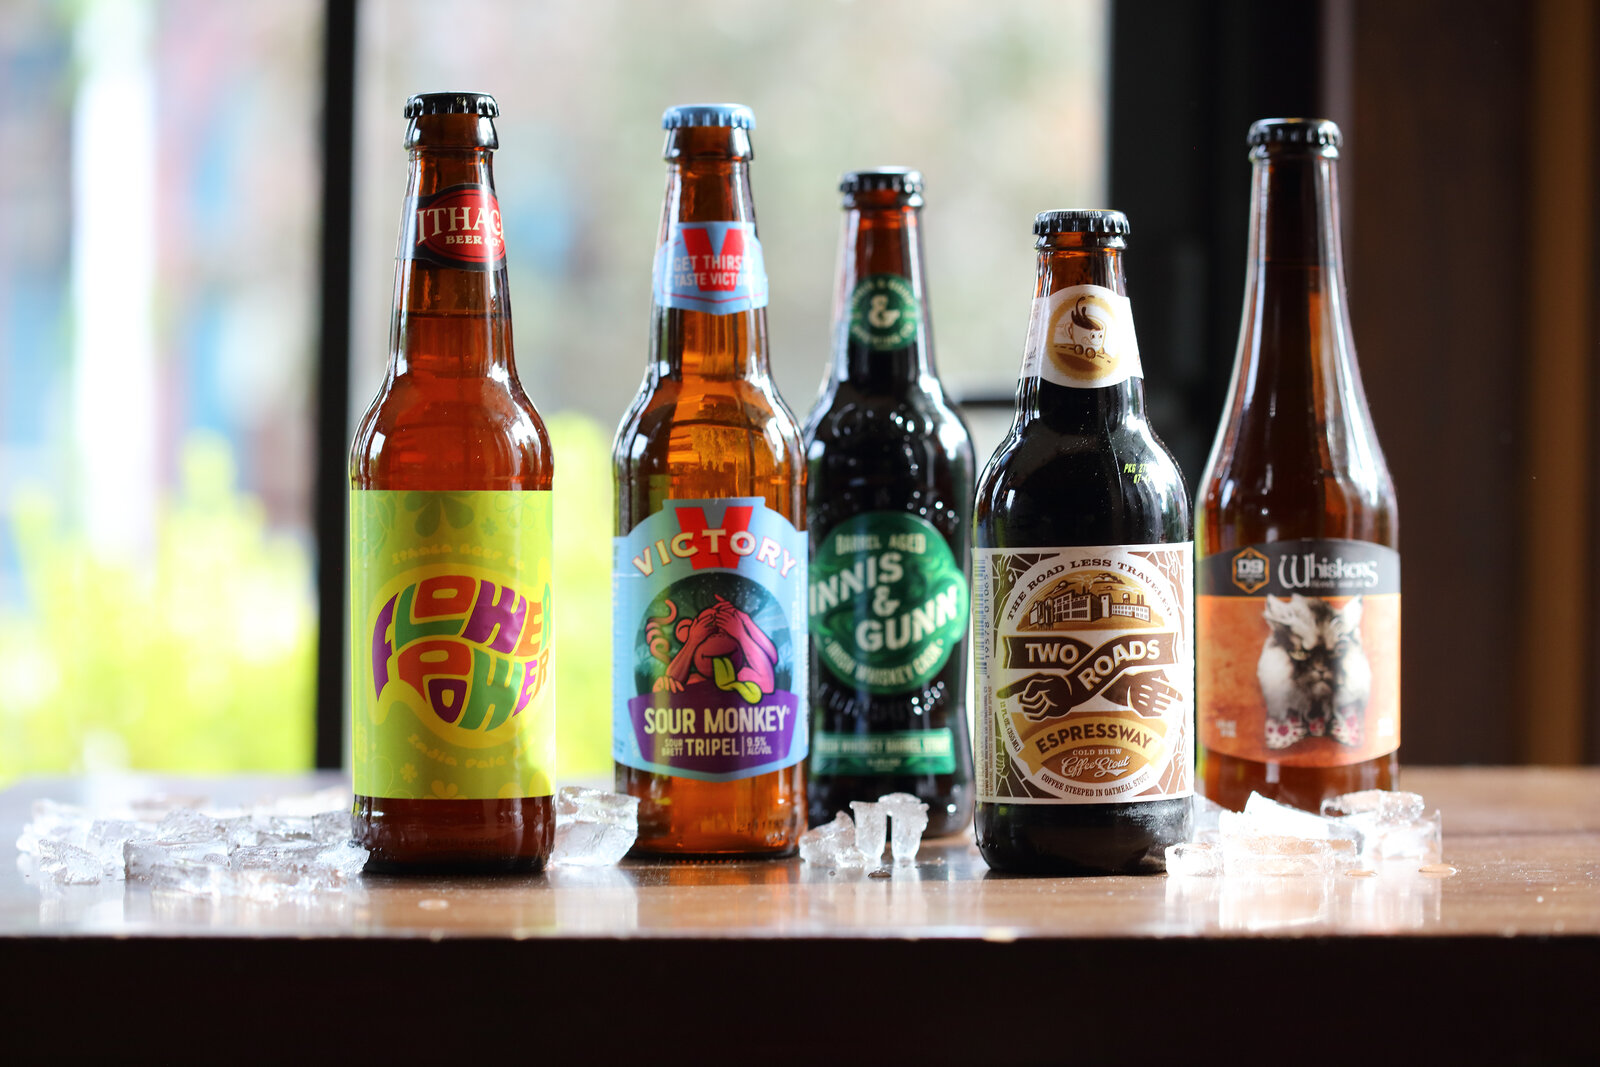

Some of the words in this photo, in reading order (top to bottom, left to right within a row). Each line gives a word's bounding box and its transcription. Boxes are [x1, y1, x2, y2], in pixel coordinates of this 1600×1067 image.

[417, 206, 505, 244] ITHAC
[446, 235, 483, 245] BEER
[674, 255, 698, 271] GET
[674, 272, 707, 287] TASTE
[632, 529, 797, 578] VICTORY
[809, 551, 904, 617] INNIS
[1007, 591, 1027, 620] THE
[1026, 564, 1065, 591] ROAD
[1070, 558, 1112, 569] LESS
[855, 585, 957, 653] GUNN
[1025, 643, 1080, 664] TWO
[1077, 639, 1162, 692] ROADS
[644, 708, 696, 734] SOUR
[685, 738, 739, 756] TRIPEL
[1035, 723, 1153, 754] ESPRESSWAY
[1072, 748, 1096, 756] COLD
[1061, 756, 1096, 778] Coffee
[1094, 755, 1131, 778] Stout
[1041, 773, 1065, 791] COFFEE
[1065, 783, 1095, 797] STEEPED
[1095, 788, 1104, 797] IN
[1104, 782, 1133, 796] OATMEAL
